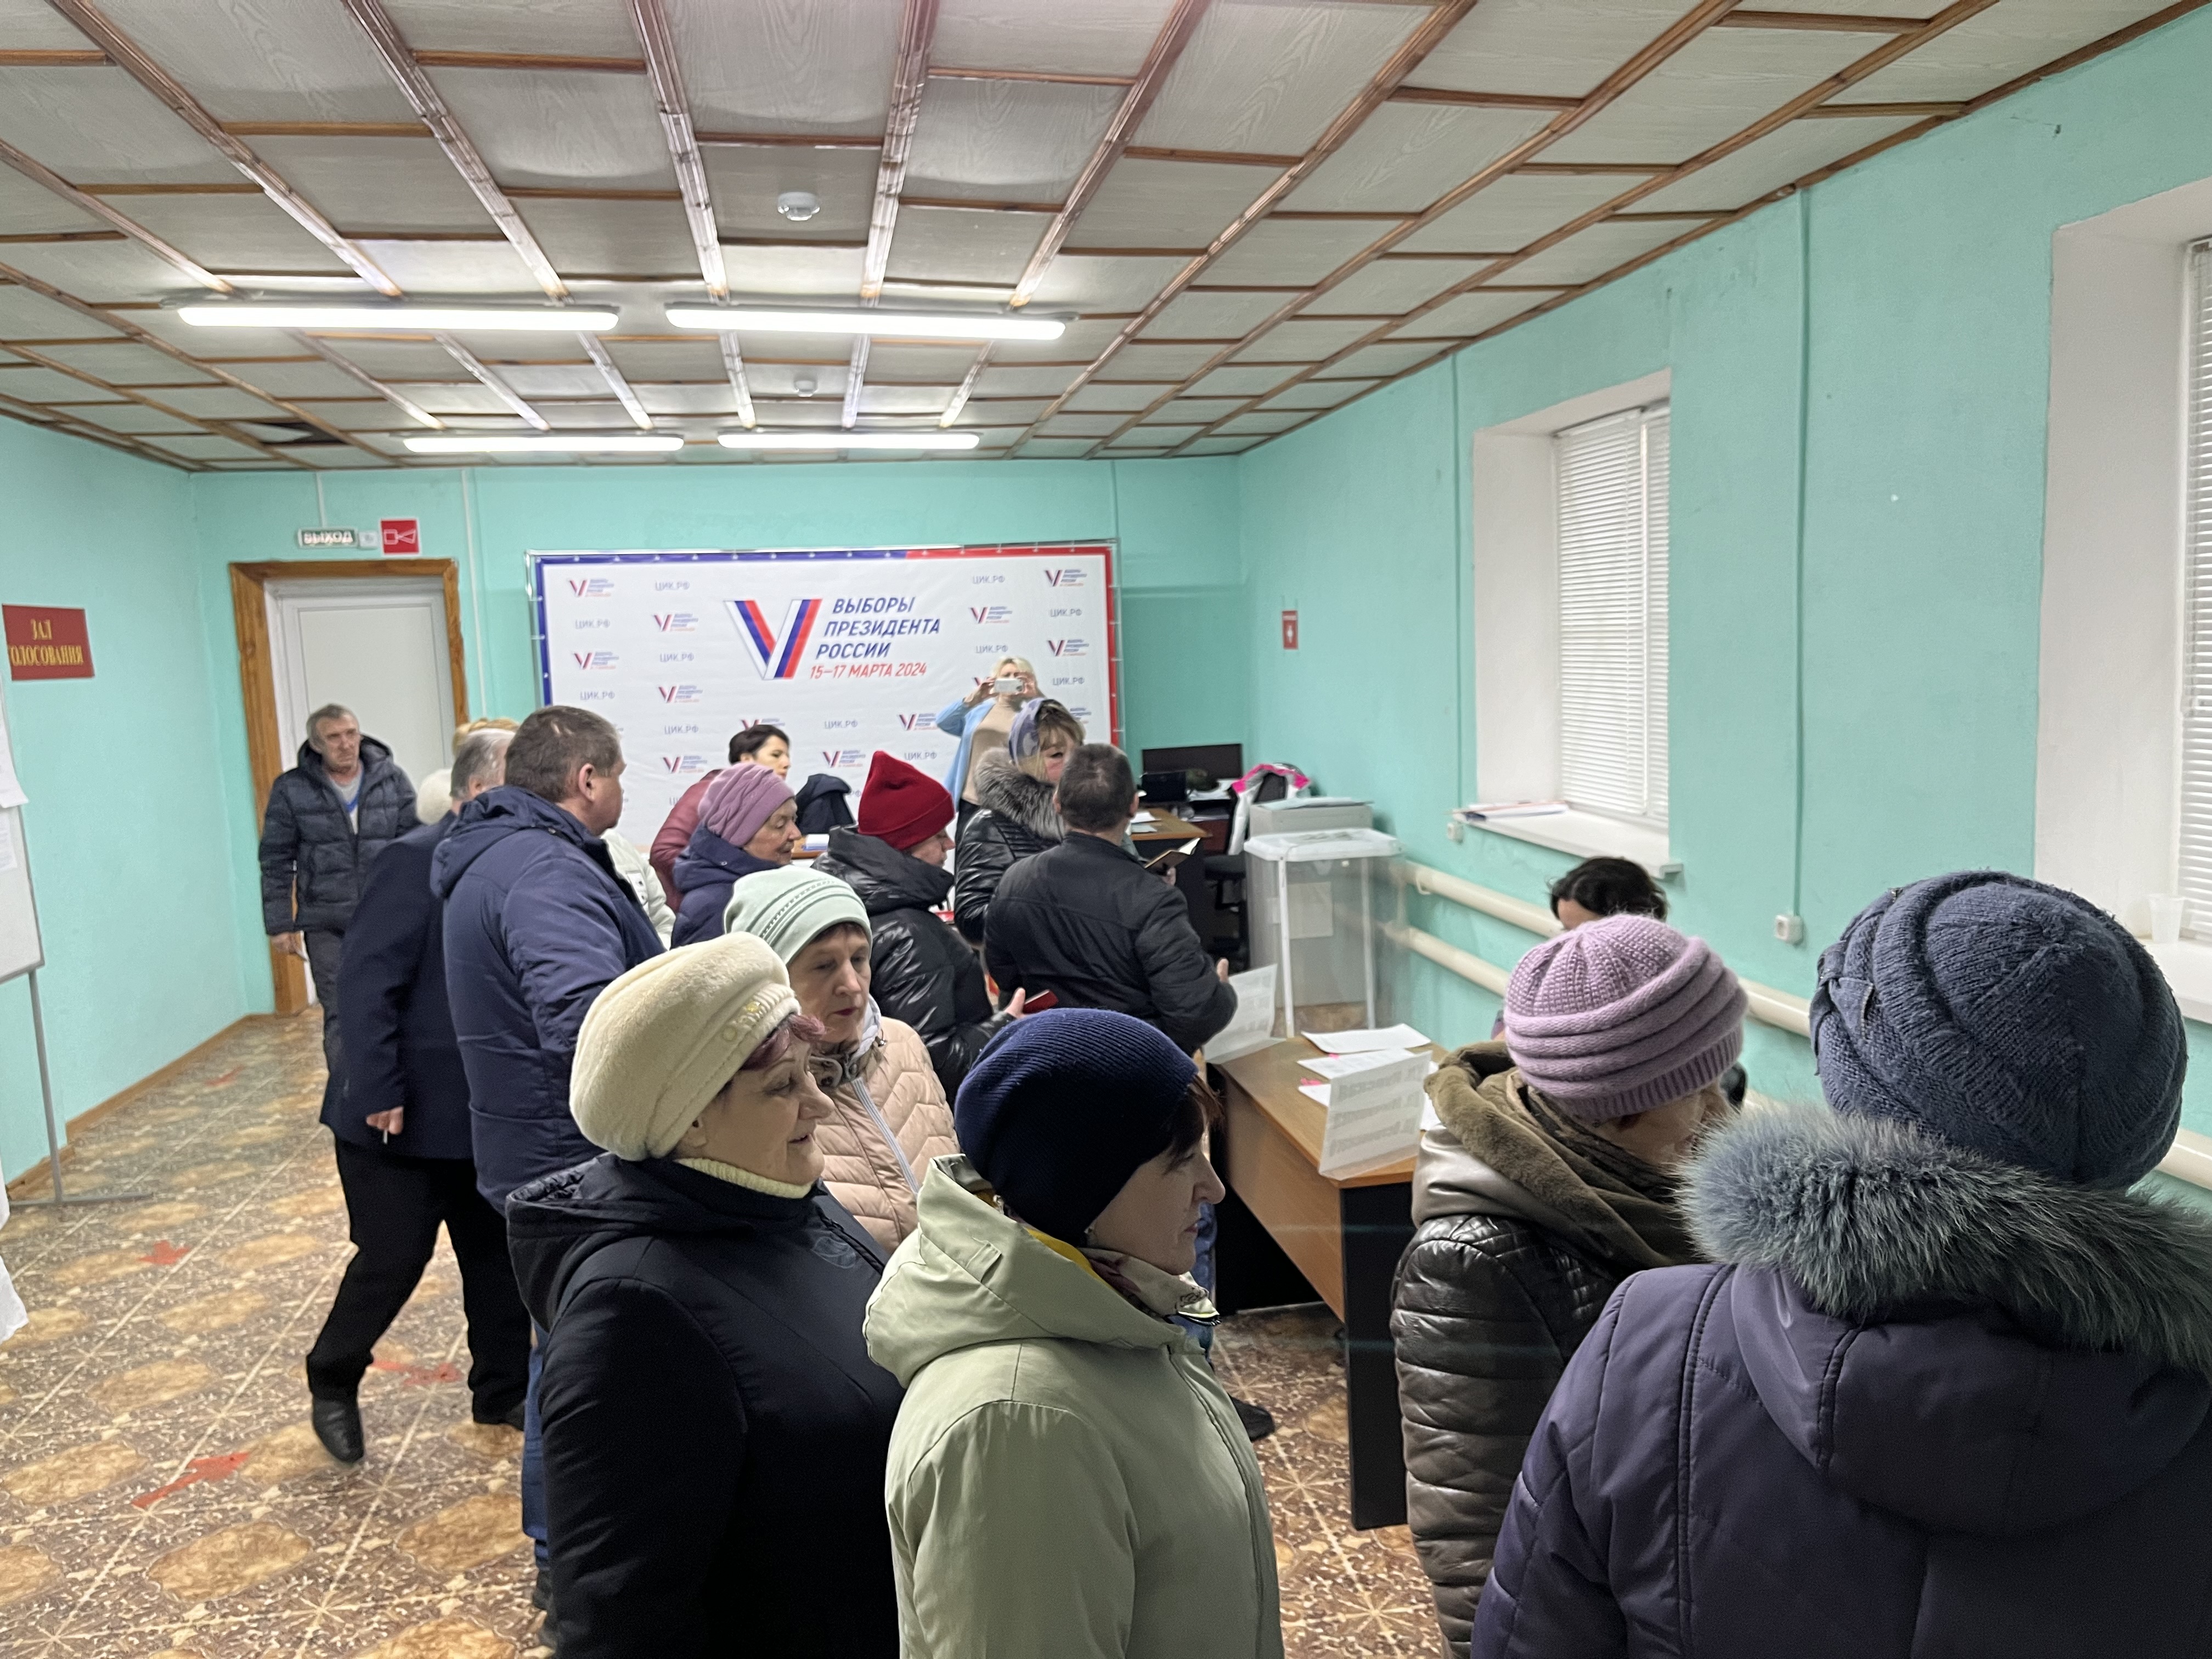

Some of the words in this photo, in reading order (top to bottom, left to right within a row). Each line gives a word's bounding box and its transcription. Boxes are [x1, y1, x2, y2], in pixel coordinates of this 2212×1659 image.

[304, 530, 354, 544] ВЫХОД
[832, 596, 916, 614] ВЫБОРЫ
[31, 619, 52, 641] ЗАЛ
[823, 618, 941, 638] ПРЕЗИДЕНТА
[9, 645, 84, 667] ОЛОСОВАНИЯ
[815, 642, 891, 660] РОССИИ
[848, 663, 892, 678] МАРТА
[895, 662, 927, 677] 2024
